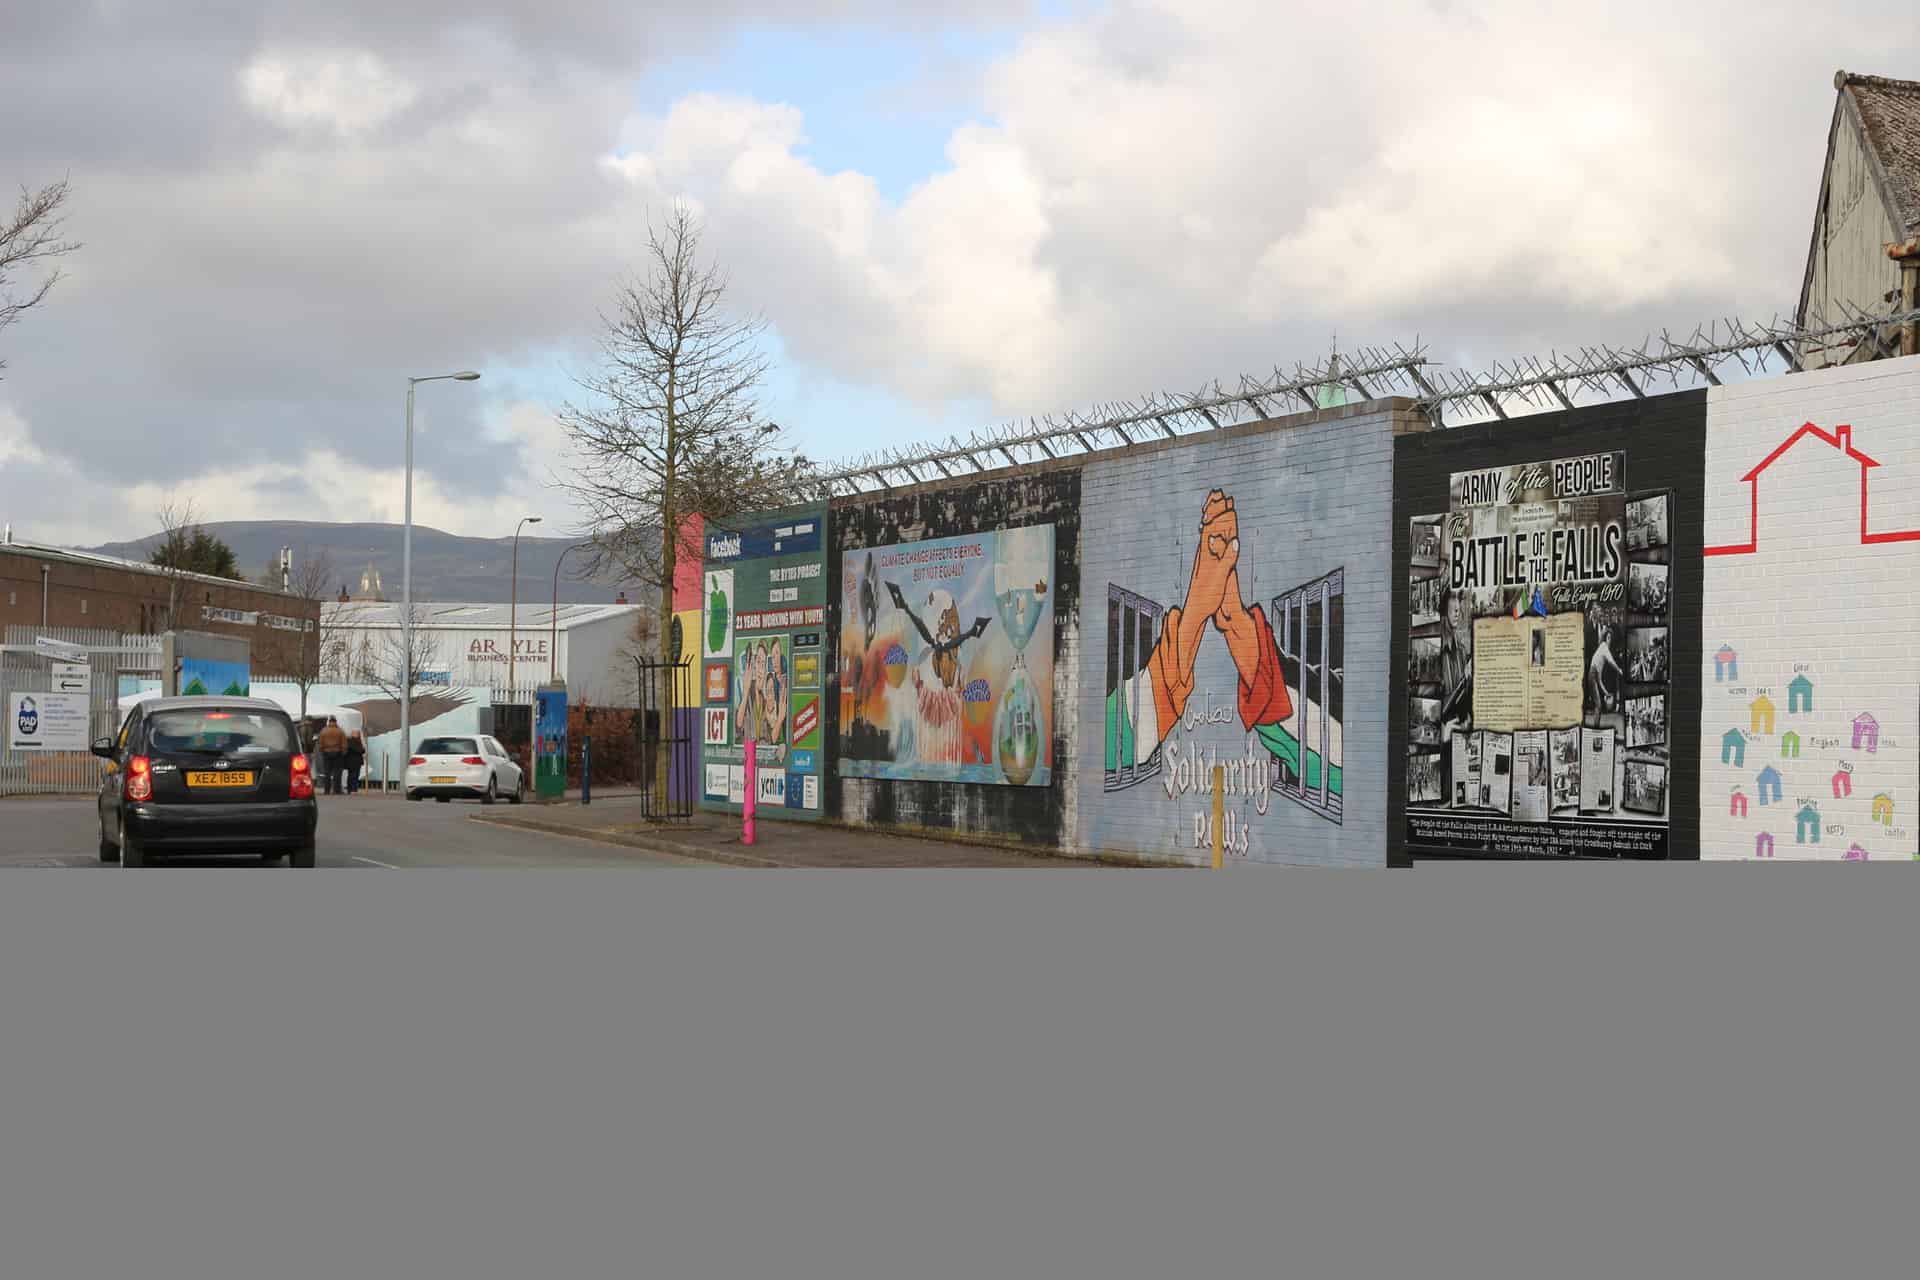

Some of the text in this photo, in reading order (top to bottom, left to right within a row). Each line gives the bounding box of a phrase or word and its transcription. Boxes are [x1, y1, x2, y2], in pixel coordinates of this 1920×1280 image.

[1461, 456, 1612, 505] ARMY of the PEOPLE
[710, 533, 741, 559] facebook
[1451, 524, 1620, 589] BATTLE OF THE FALLS
[707, 711, 725, 741] ICT
[194, 773, 217, 784] XEZ
